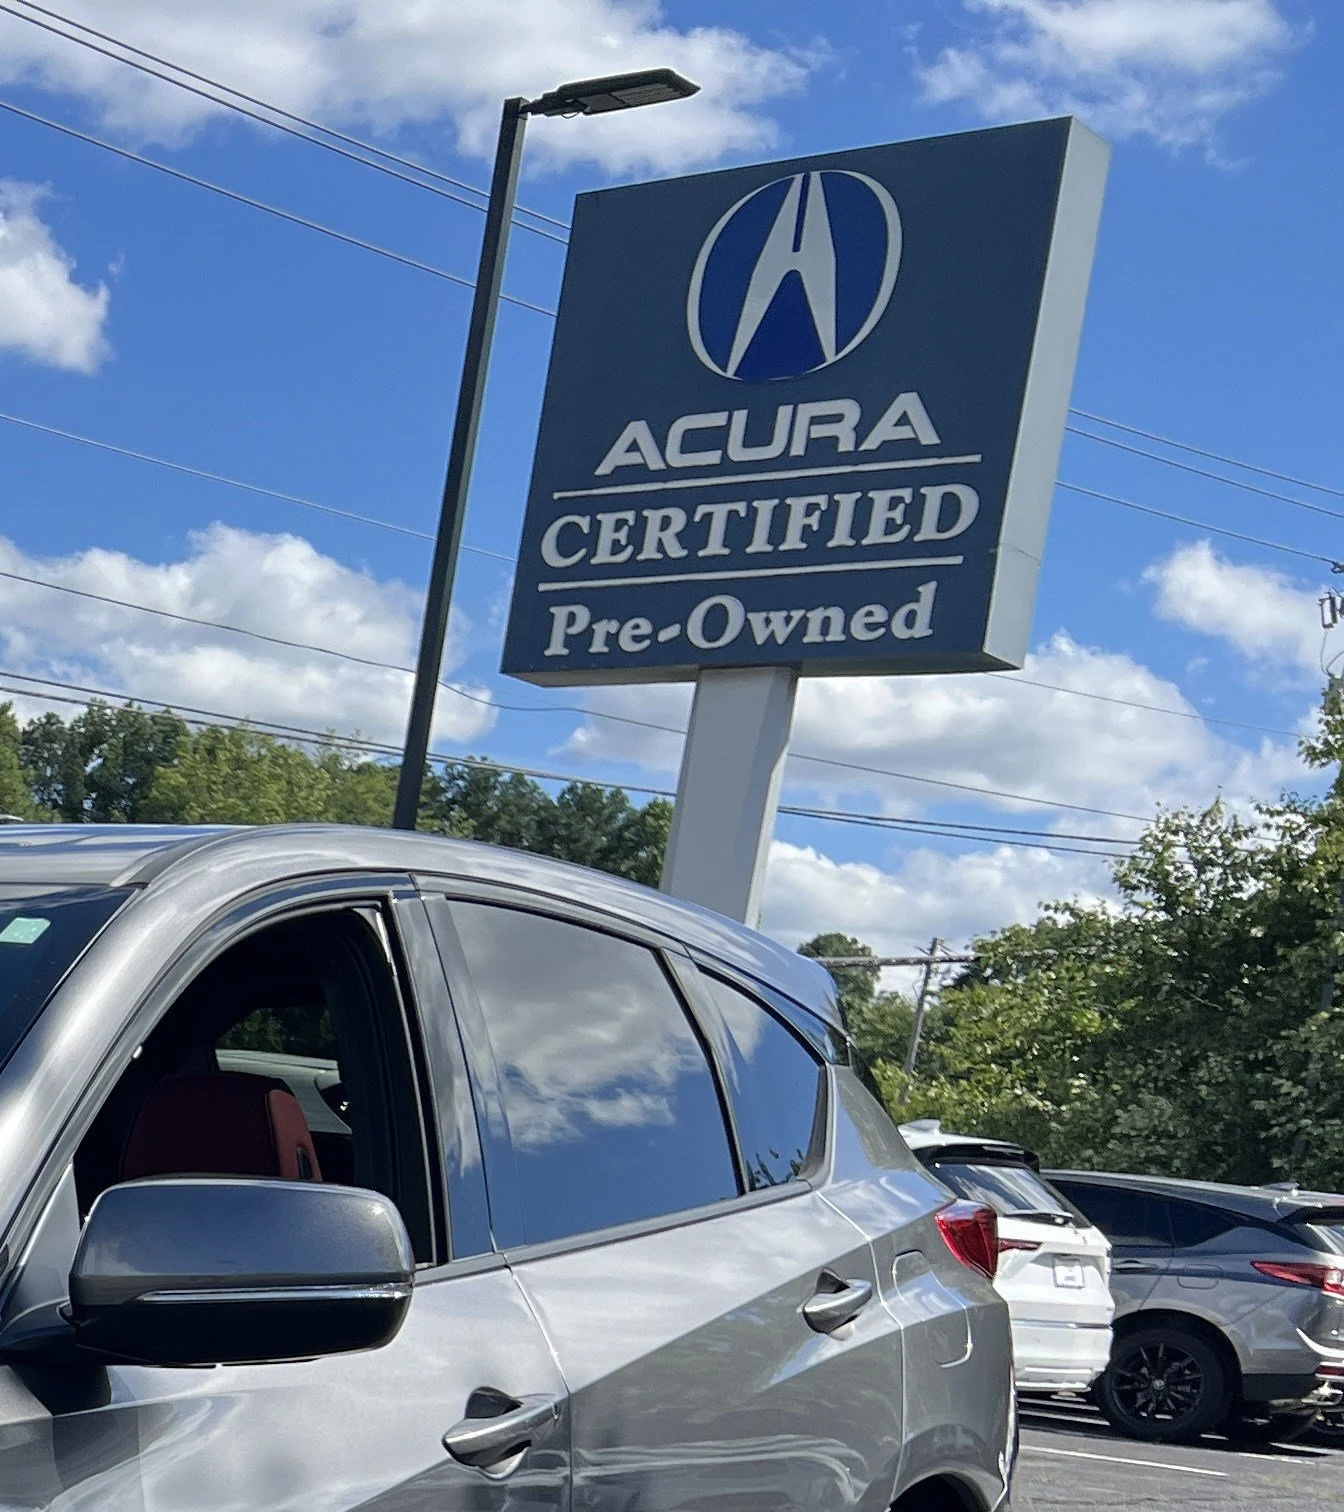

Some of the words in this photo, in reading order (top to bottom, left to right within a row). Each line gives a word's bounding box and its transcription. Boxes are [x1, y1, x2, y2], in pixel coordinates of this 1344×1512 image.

[593, 391, 941, 476] ACURA
[540, 483, 981, 569] CERTIFIED
[543, 581, 939, 658] Pre-Owned
